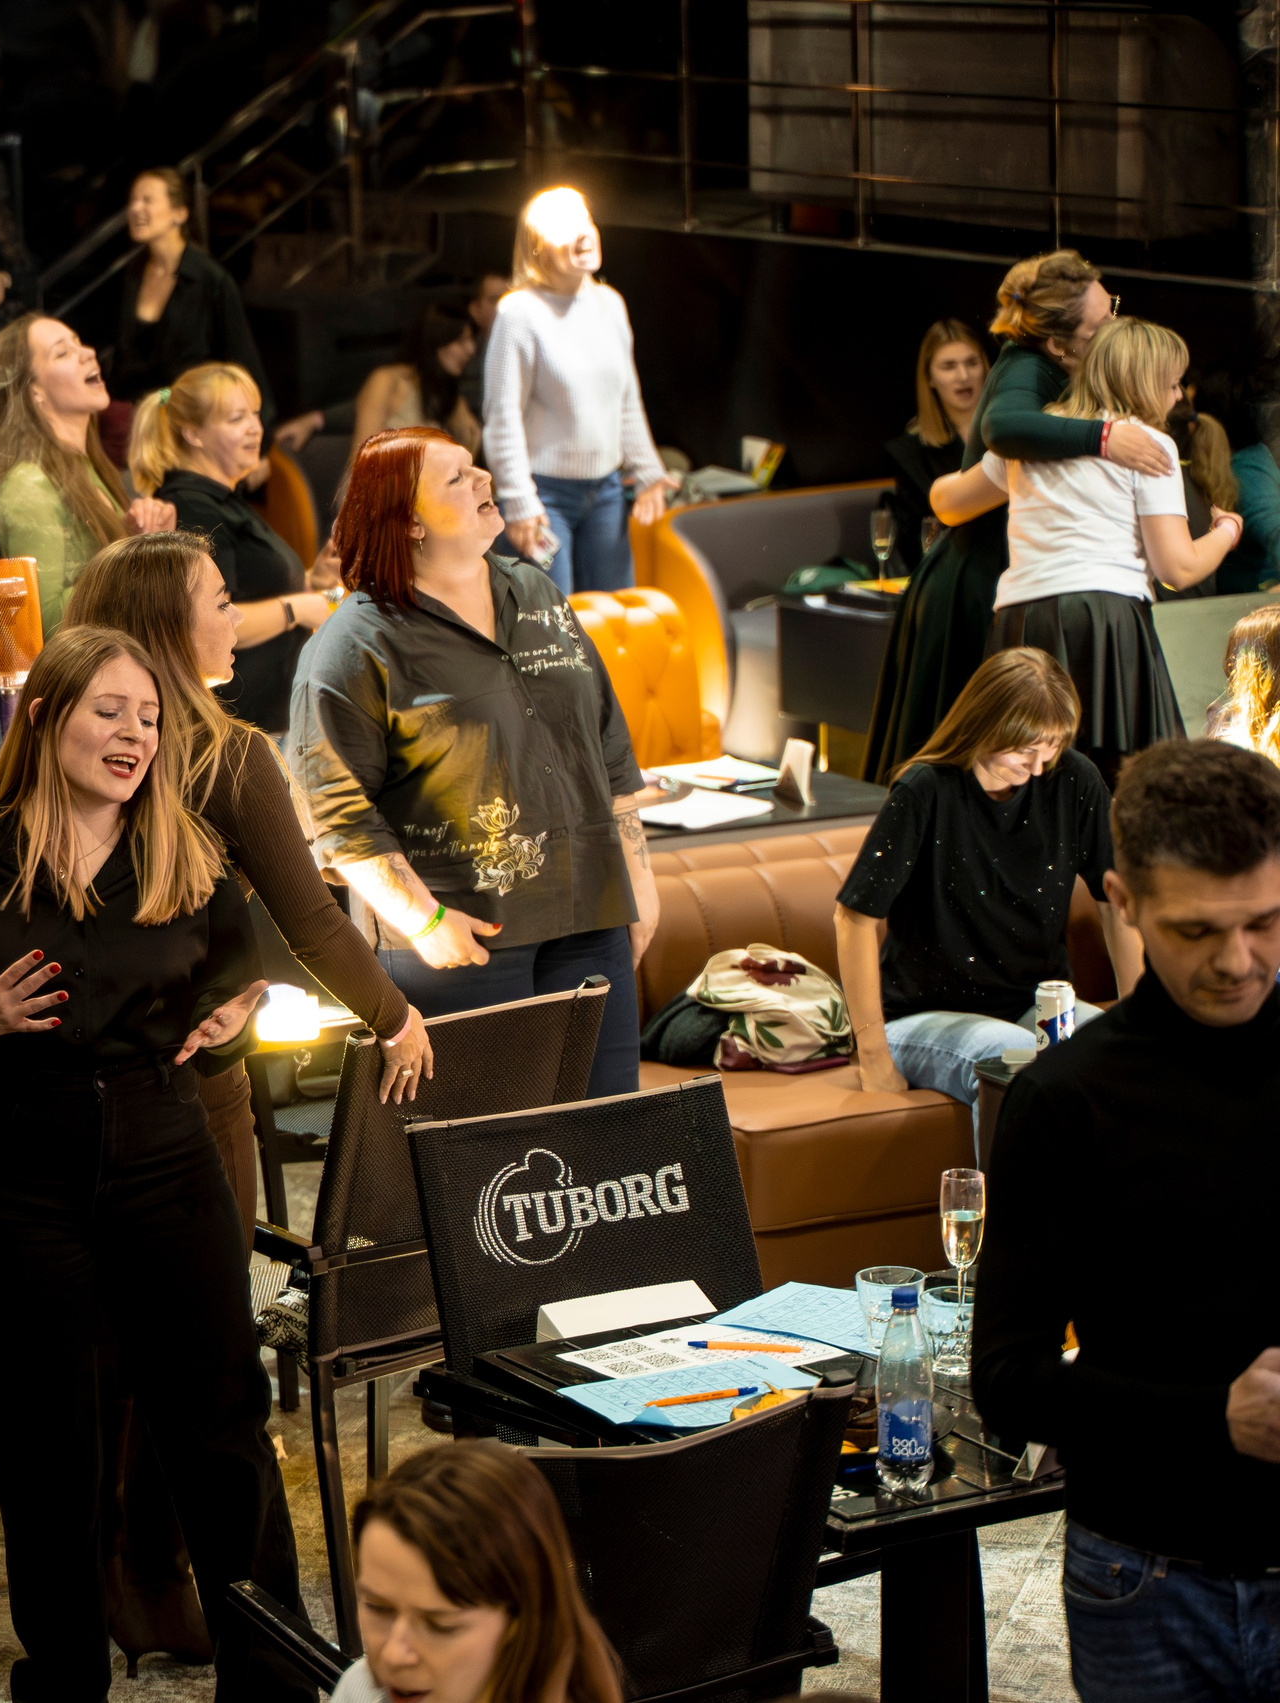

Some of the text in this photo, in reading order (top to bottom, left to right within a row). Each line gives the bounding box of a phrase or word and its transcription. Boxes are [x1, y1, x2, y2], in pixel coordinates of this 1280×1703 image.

[532, 648, 548, 656] are
[547, 644, 563, 656] the
[502, 1162, 690, 1242] TUBORG
[892, 1436, 918, 1448] bon
[892, 1446, 925, 1458] aqua
